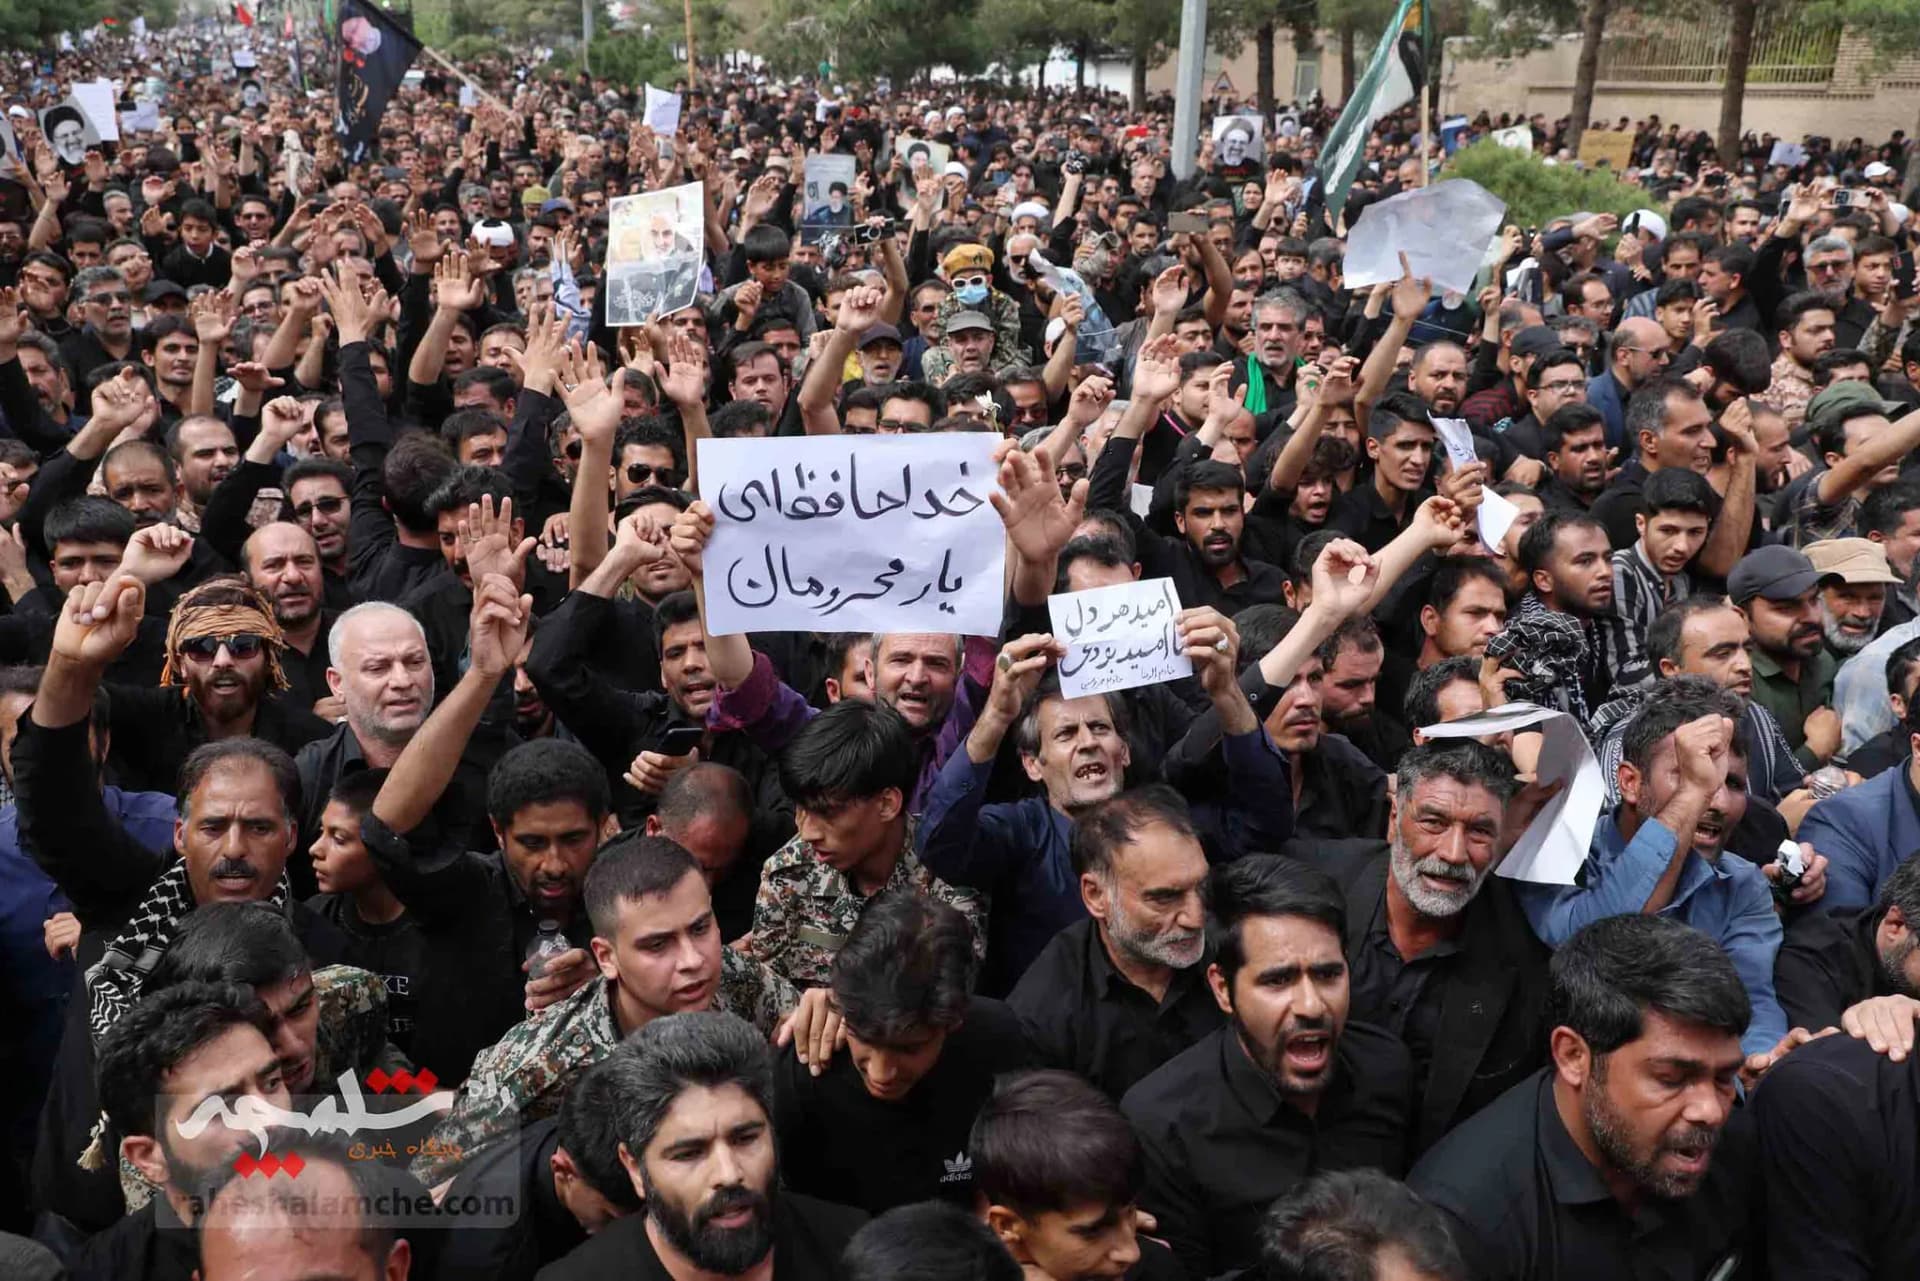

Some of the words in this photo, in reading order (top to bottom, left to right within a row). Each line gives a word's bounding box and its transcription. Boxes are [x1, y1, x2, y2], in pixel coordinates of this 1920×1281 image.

[727, 544, 905, 616] محرومان
[898, 548, 962, 614] یار
[1129, 579, 1174, 628] امید
[1065, 598, 1099, 638] دل
[1096, 604, 1130, 632] هر
